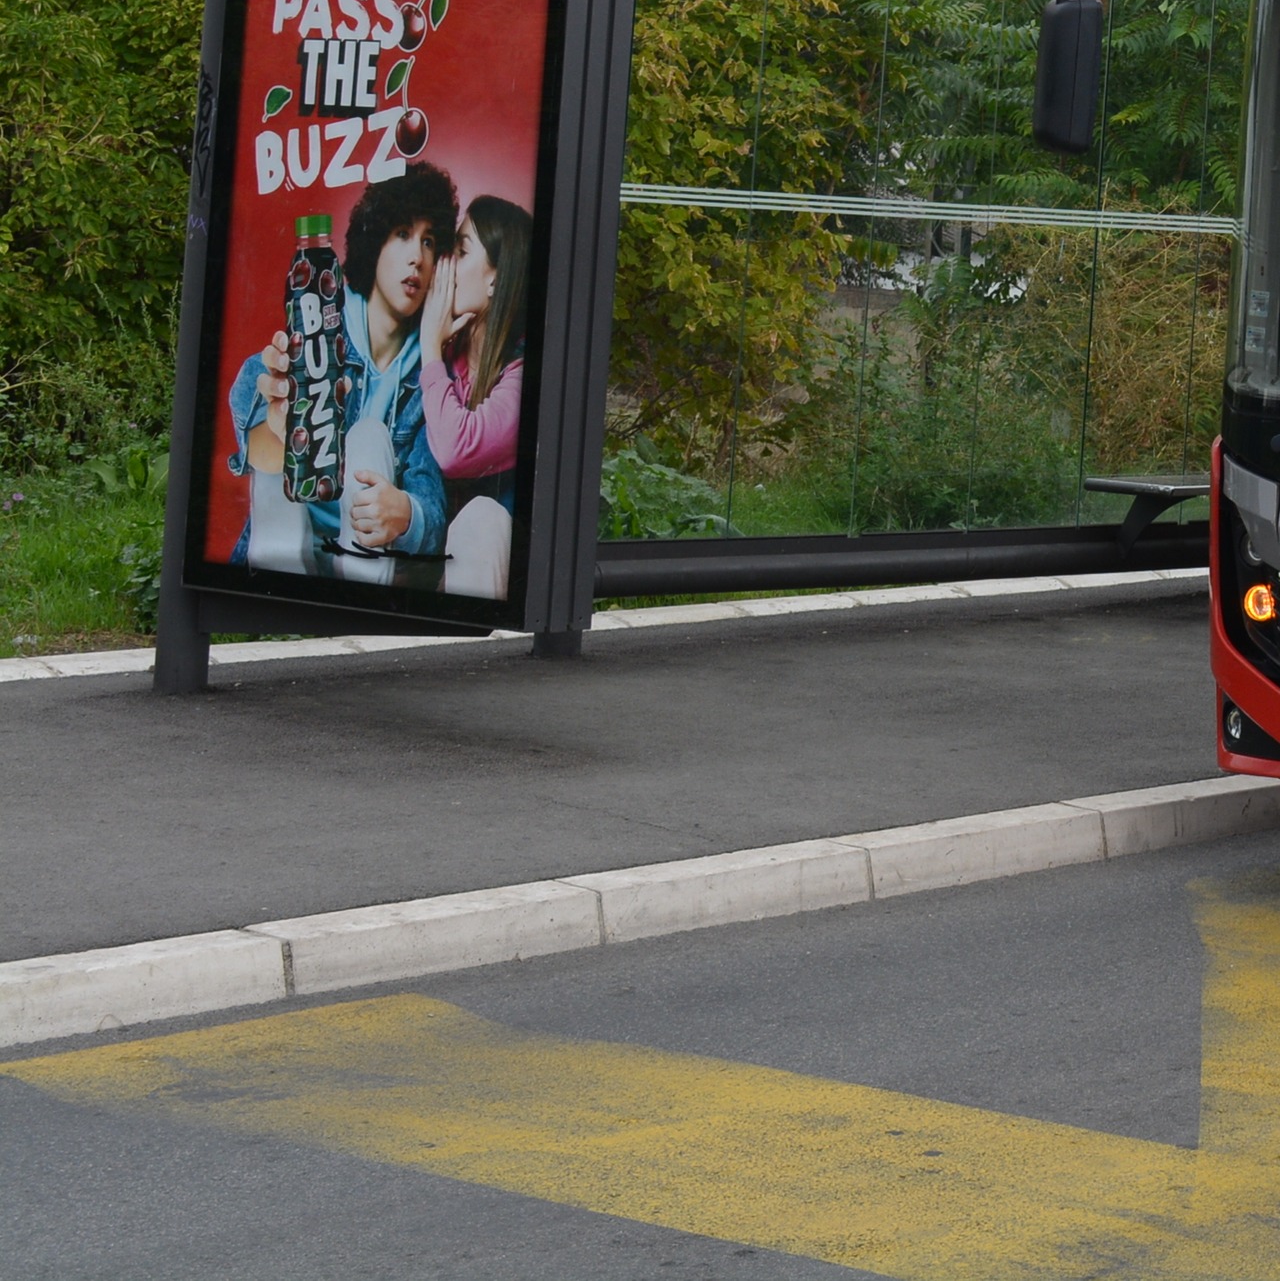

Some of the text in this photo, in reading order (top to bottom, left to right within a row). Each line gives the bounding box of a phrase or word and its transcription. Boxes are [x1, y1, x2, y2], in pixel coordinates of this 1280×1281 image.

[300, 38, 379, 110] THE
[255, 115, 406, 195] BUZZ
[300, 292, 337, 467] BUZZ
